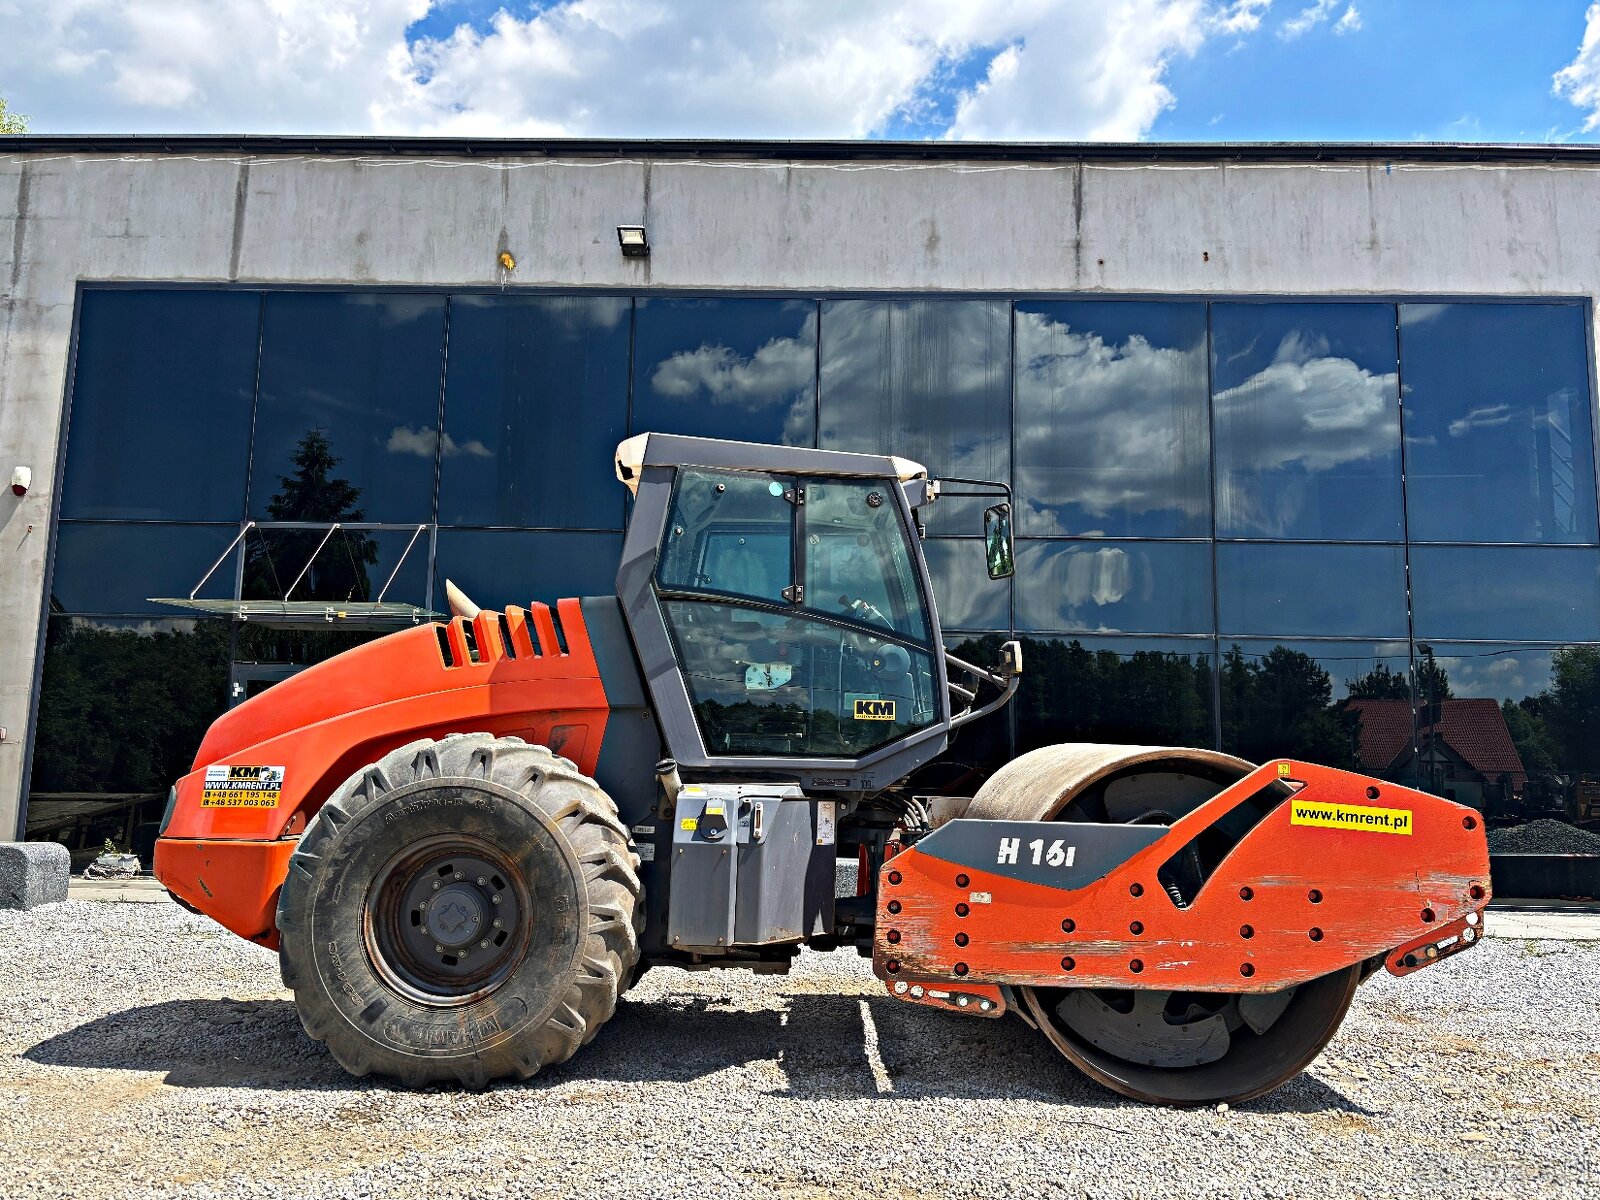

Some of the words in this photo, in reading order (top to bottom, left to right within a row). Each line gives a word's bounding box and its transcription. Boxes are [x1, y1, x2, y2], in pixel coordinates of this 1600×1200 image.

[856, 701, 893, 715] KM
[230, 767, 261, 778] KM
[204, 781, 281, 790] WWW.KMRENT.PL
[263, 791, 277, 799] 148
[260, 799, 275, 807] 063
[1295, 808, 1408, 830] www.kmrent.pl
[996, 837, 1021, 865] H
